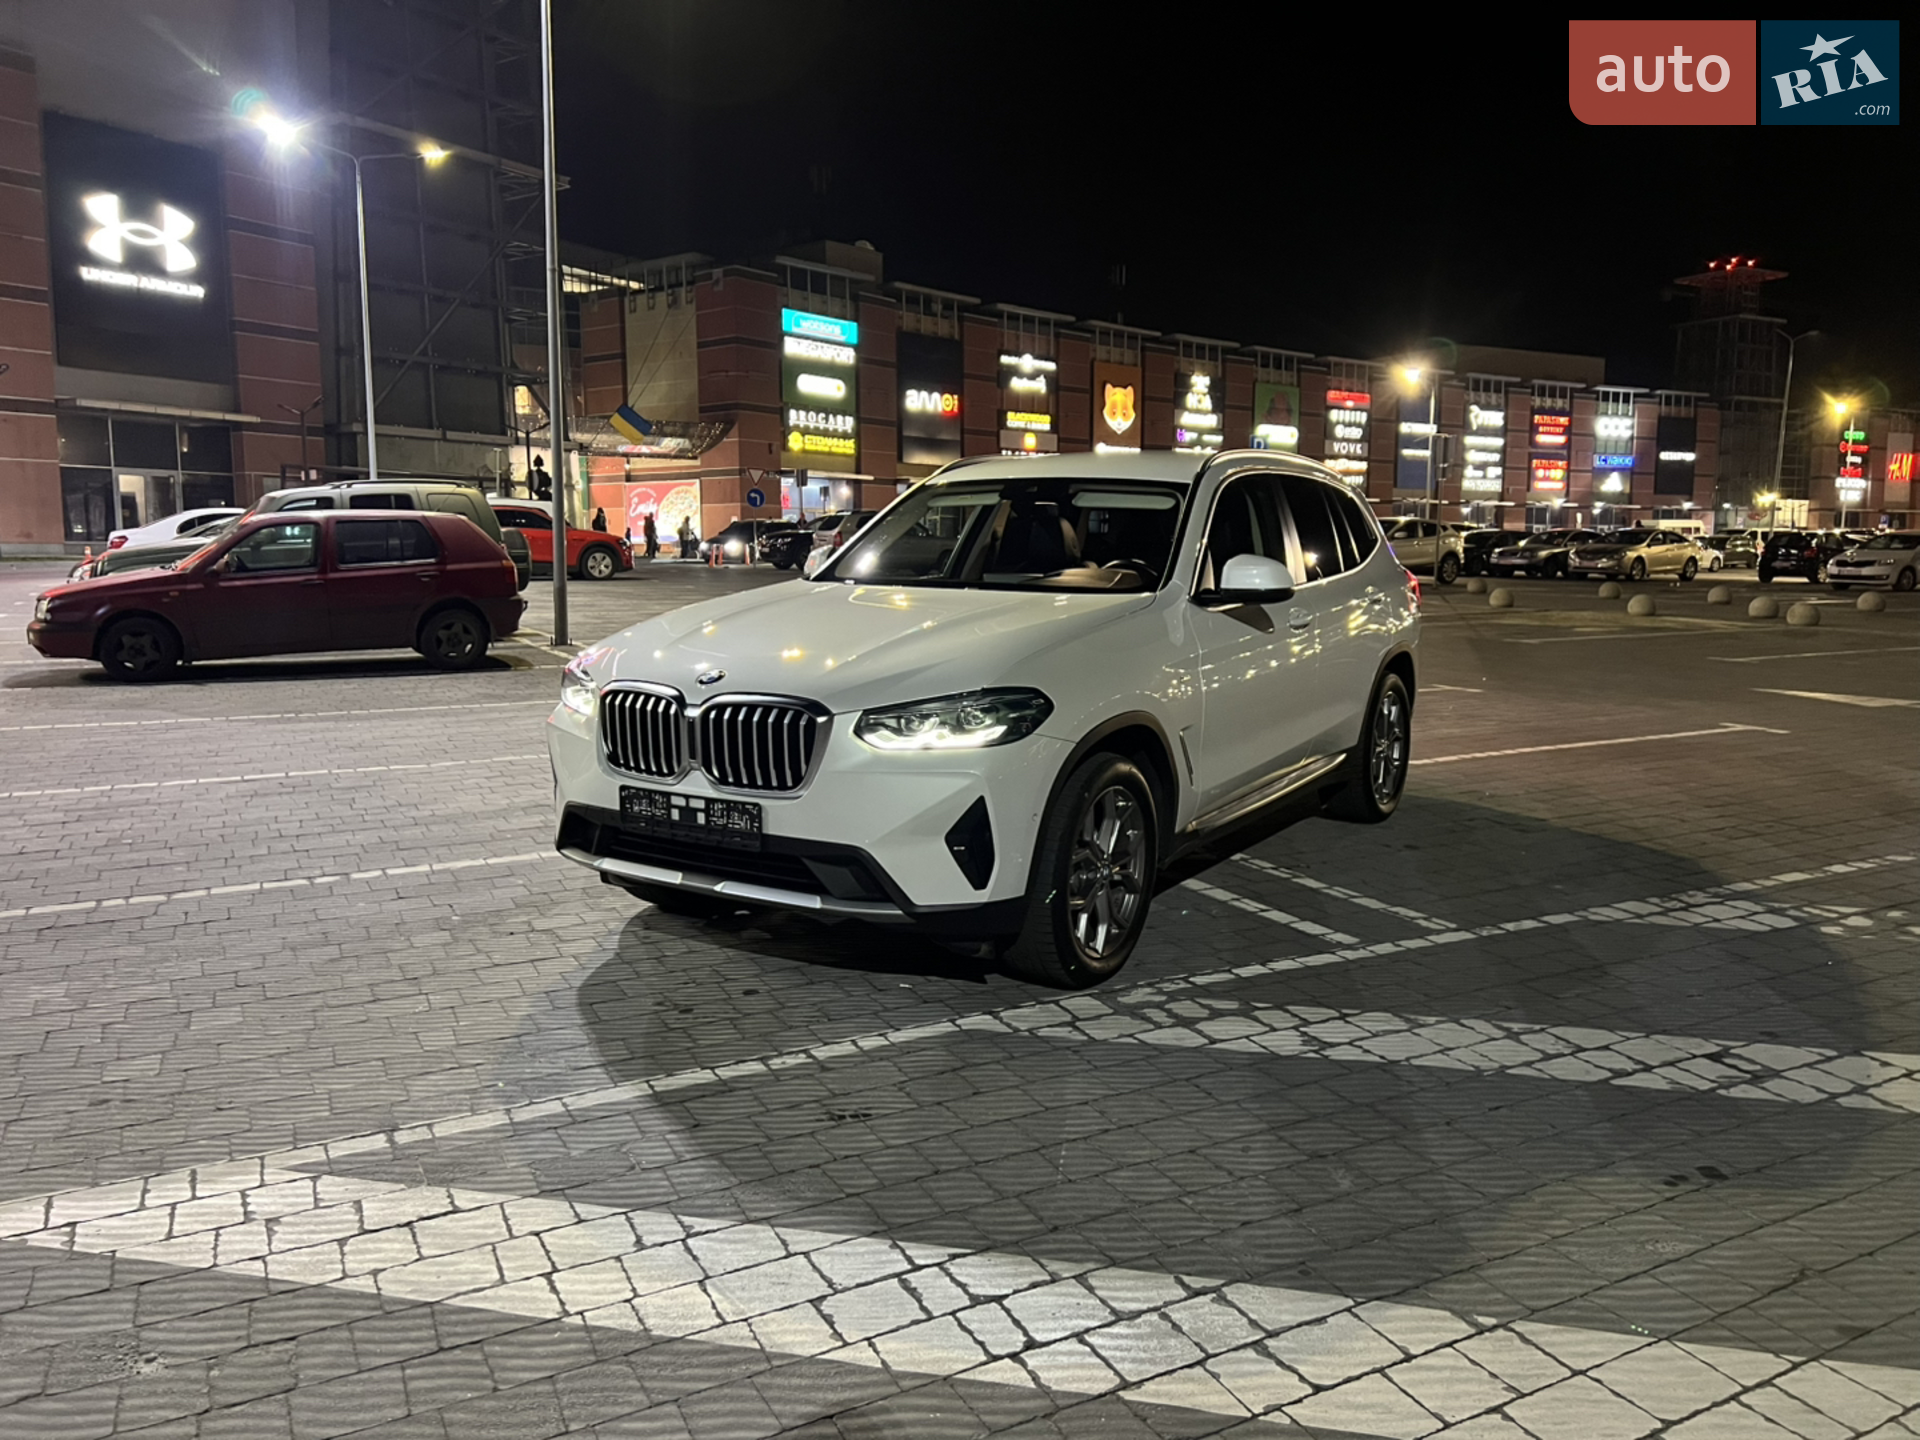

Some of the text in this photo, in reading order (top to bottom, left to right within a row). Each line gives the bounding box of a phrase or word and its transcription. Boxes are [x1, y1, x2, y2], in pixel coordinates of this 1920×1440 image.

[79, 265, 206, 299] UNDER ARMOUR
[789, 408, 854, 429] BROCARD
[1333, 441, 1362, 454] VOVK
